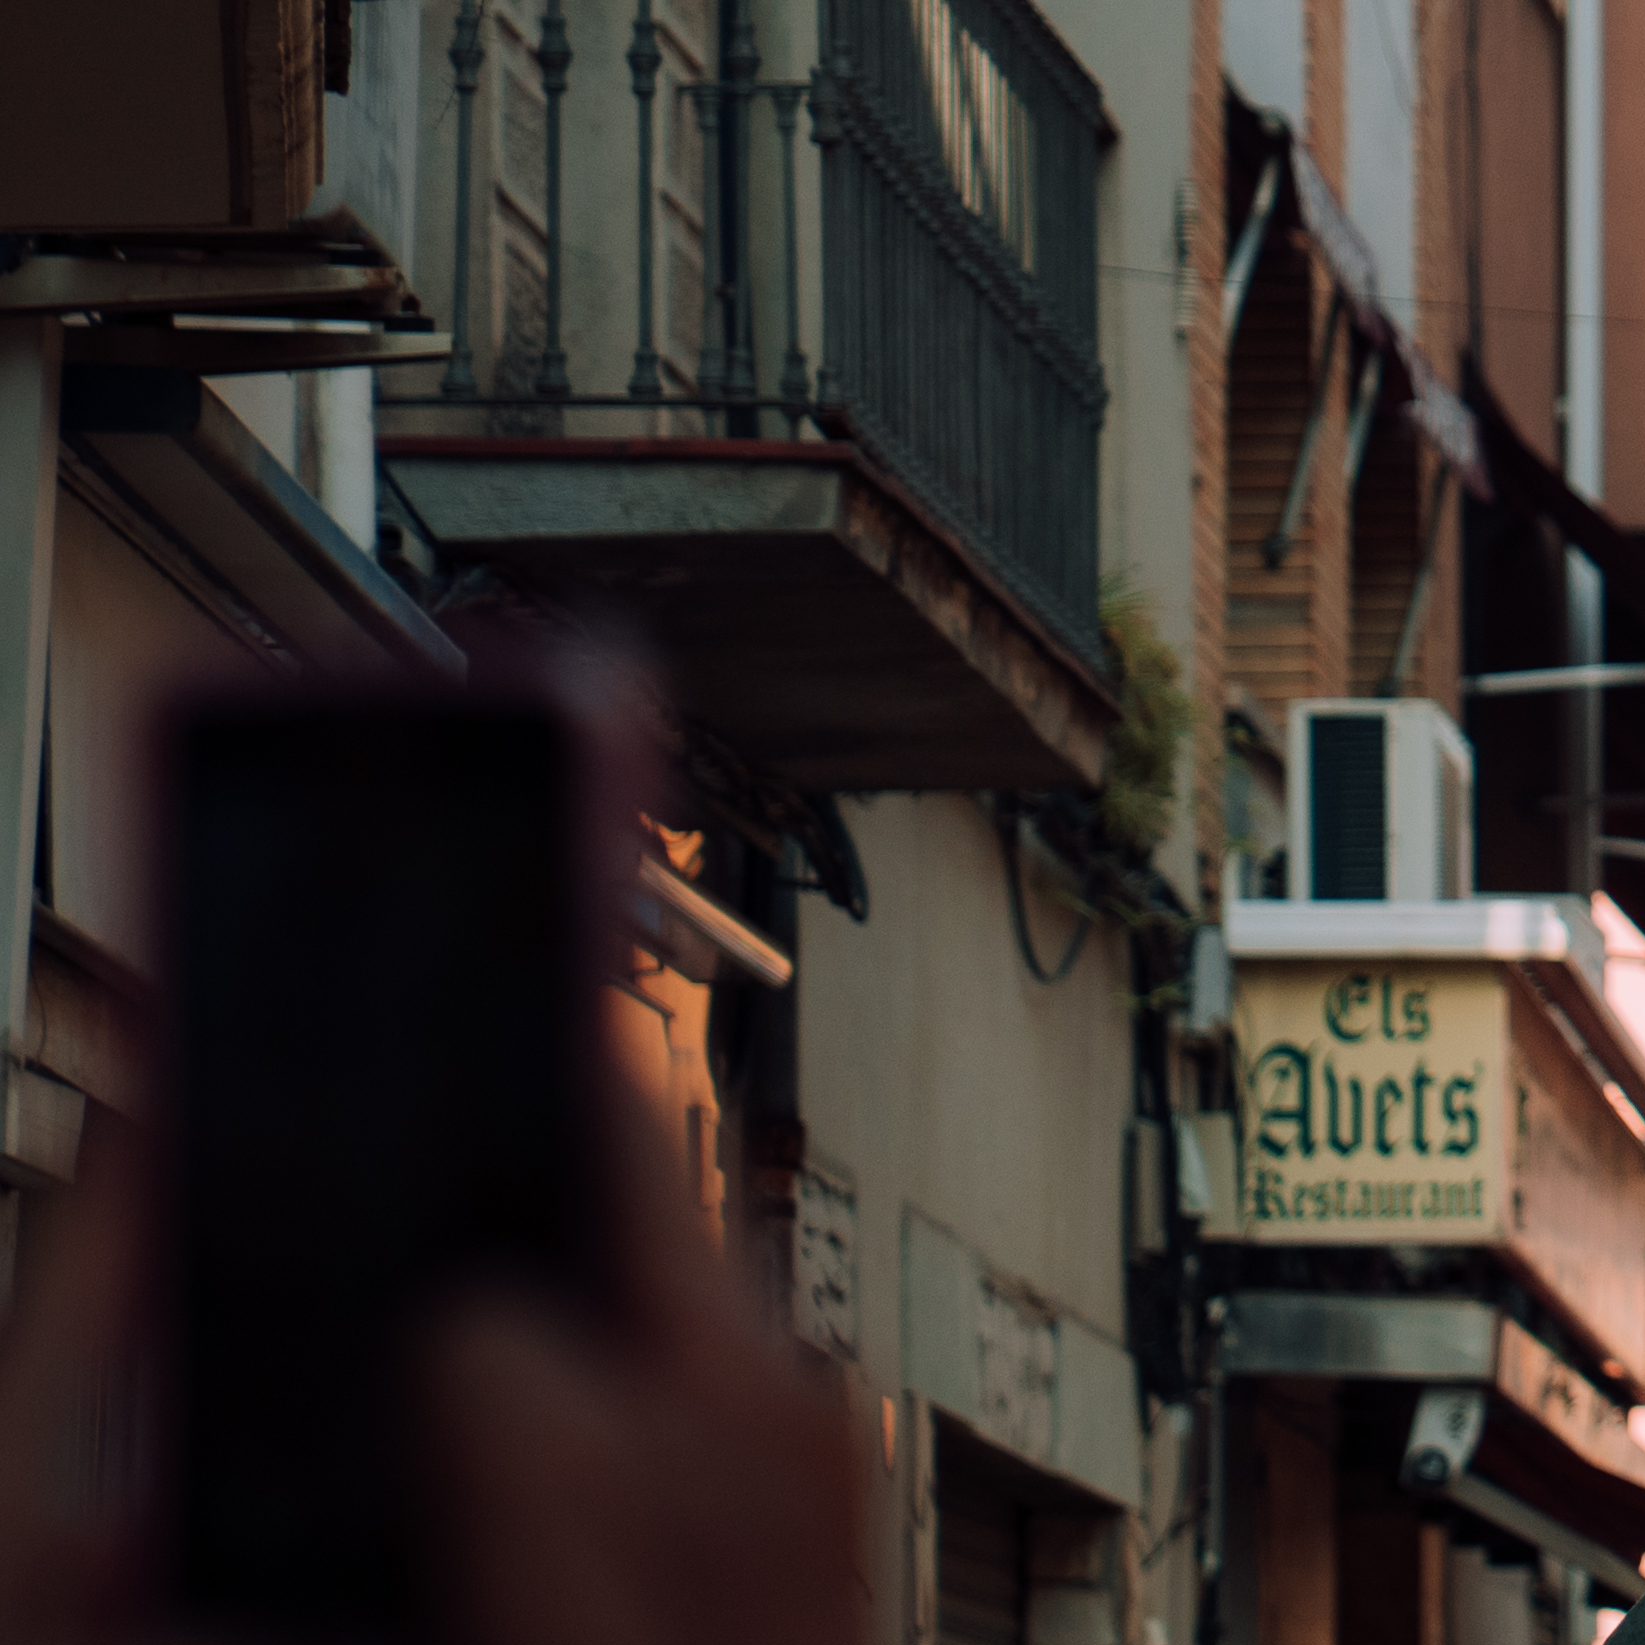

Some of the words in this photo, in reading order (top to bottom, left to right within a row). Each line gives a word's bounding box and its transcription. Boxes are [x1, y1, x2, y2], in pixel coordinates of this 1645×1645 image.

[1322, 974, 1433, 1044] Els
[1246, 1042, 1484, 1160] Avets
[1250, 1167, 1485, 1222] Restaurant
